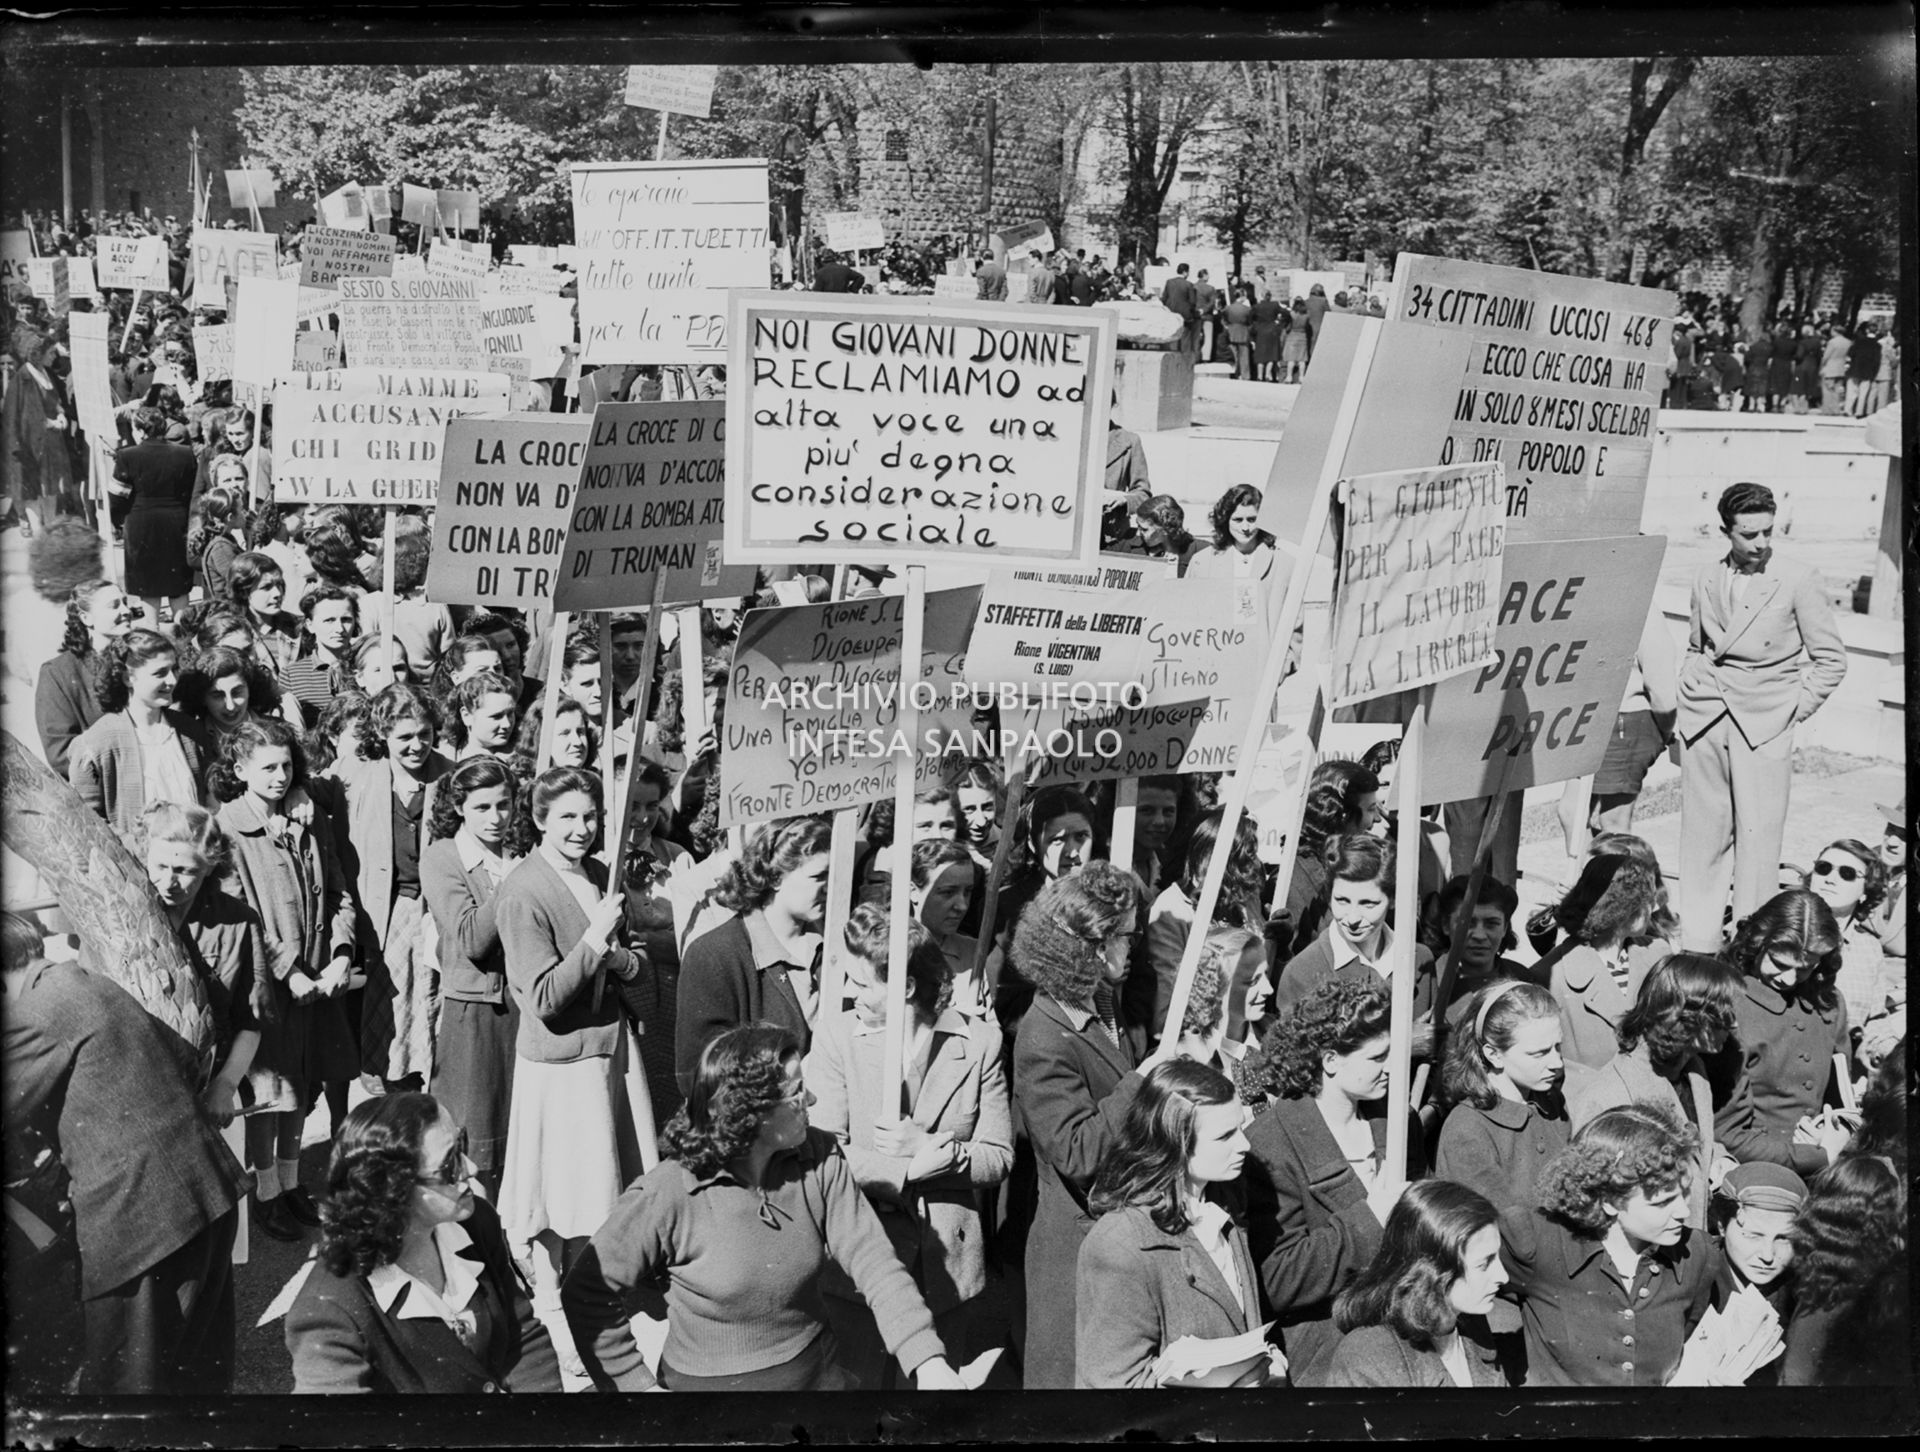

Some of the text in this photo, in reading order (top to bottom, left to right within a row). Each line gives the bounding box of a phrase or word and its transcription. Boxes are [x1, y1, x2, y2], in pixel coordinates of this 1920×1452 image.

[308, 226, 380, 242] LICENZIANDO
[315, 236, 352, 248] NOSTRI
[356, 242, 390, 252] UOMINI
[306, 246, 391, 263] VOI AFFAMATE
[325, 260, 370, 273] NOSTRI
[342, 279, 385, 299] SESTO
[391, 280, 406, 299] S.
[408, 280, 476, 299] GIOVANNI
[639, 306, 662, 342] la
[1407, 284, 1662, 351] 34 CITTADINI UCCISI 468
[753, 317, 1083, 365] NOI GIOVANI DONNE
[753, 357, 1087, 403] RECLAMIAMO ad
[1482, 342, 1647, 391] ECCO CHE COSA HA
[305, 371, 480, 400] LE MAMME
[754, 398, 1059, 439] alta voce una
[1453, 387, 1651, 439] IN SOLO 8 MESI SCELBA
[290, 438, 438, 462] CHI GRID
[593, 421, 617, 447] LA
[626, 419, 680, 446] CROCE
[686, 417, 706, 443] DI
[475, 438, 586, 467] LA CROC
[880, 440, 1016, 481] degna
[1517, 440, 1586, 476] POPOLO
[1594, 445, 1609, 478] E
[289, 476, 315, 498] W
[324, 477, 358, 499] LA
[456, 481, 505, 507] NON
[515, 482, 541, 508] VA
[750, 475, 1073, 516] considerazione
[572, 504, 609, 533] CON
[611, 503, 633, 531] LA
[640, 498, 695, 530] BOMBA
[1347, 487, 1375, 528] LA
[797, 513, 998, 549] sociale
[572, 543, 697, 579] DI TRUMAN
[1343, 525, 1504, 585] PER LA PACE
[476, 566, 500, 596] DI
[1102, 567, 1144, 591] POPOLARE
[984, 603, 1064, 630] STAFFETTA
[1064, 614, 1087, 632] della
[1358, 579, 1487, 639] IL LAVORO
[1496, 576, 1586, 626] ACE
[1013, 640, 1102, 662] Rione VIGENTINA
[1147, 622, 1246, 658] GOVERNO
[1033, 661, 1074, 677] (S. LUIGI)
[1343, 621, 1492, 698] LA LIBERTÀ
[1473, 640, 1588, 694] PACE
[728, 724, 773, 751] UNA
[1481, 701, 1600, 761] PACE
[1165, 735, 1239, 770] DONNE
[728, 782, 794, 820] FRONTE
[801, 761, 898, 807] DEMOCRATIC
